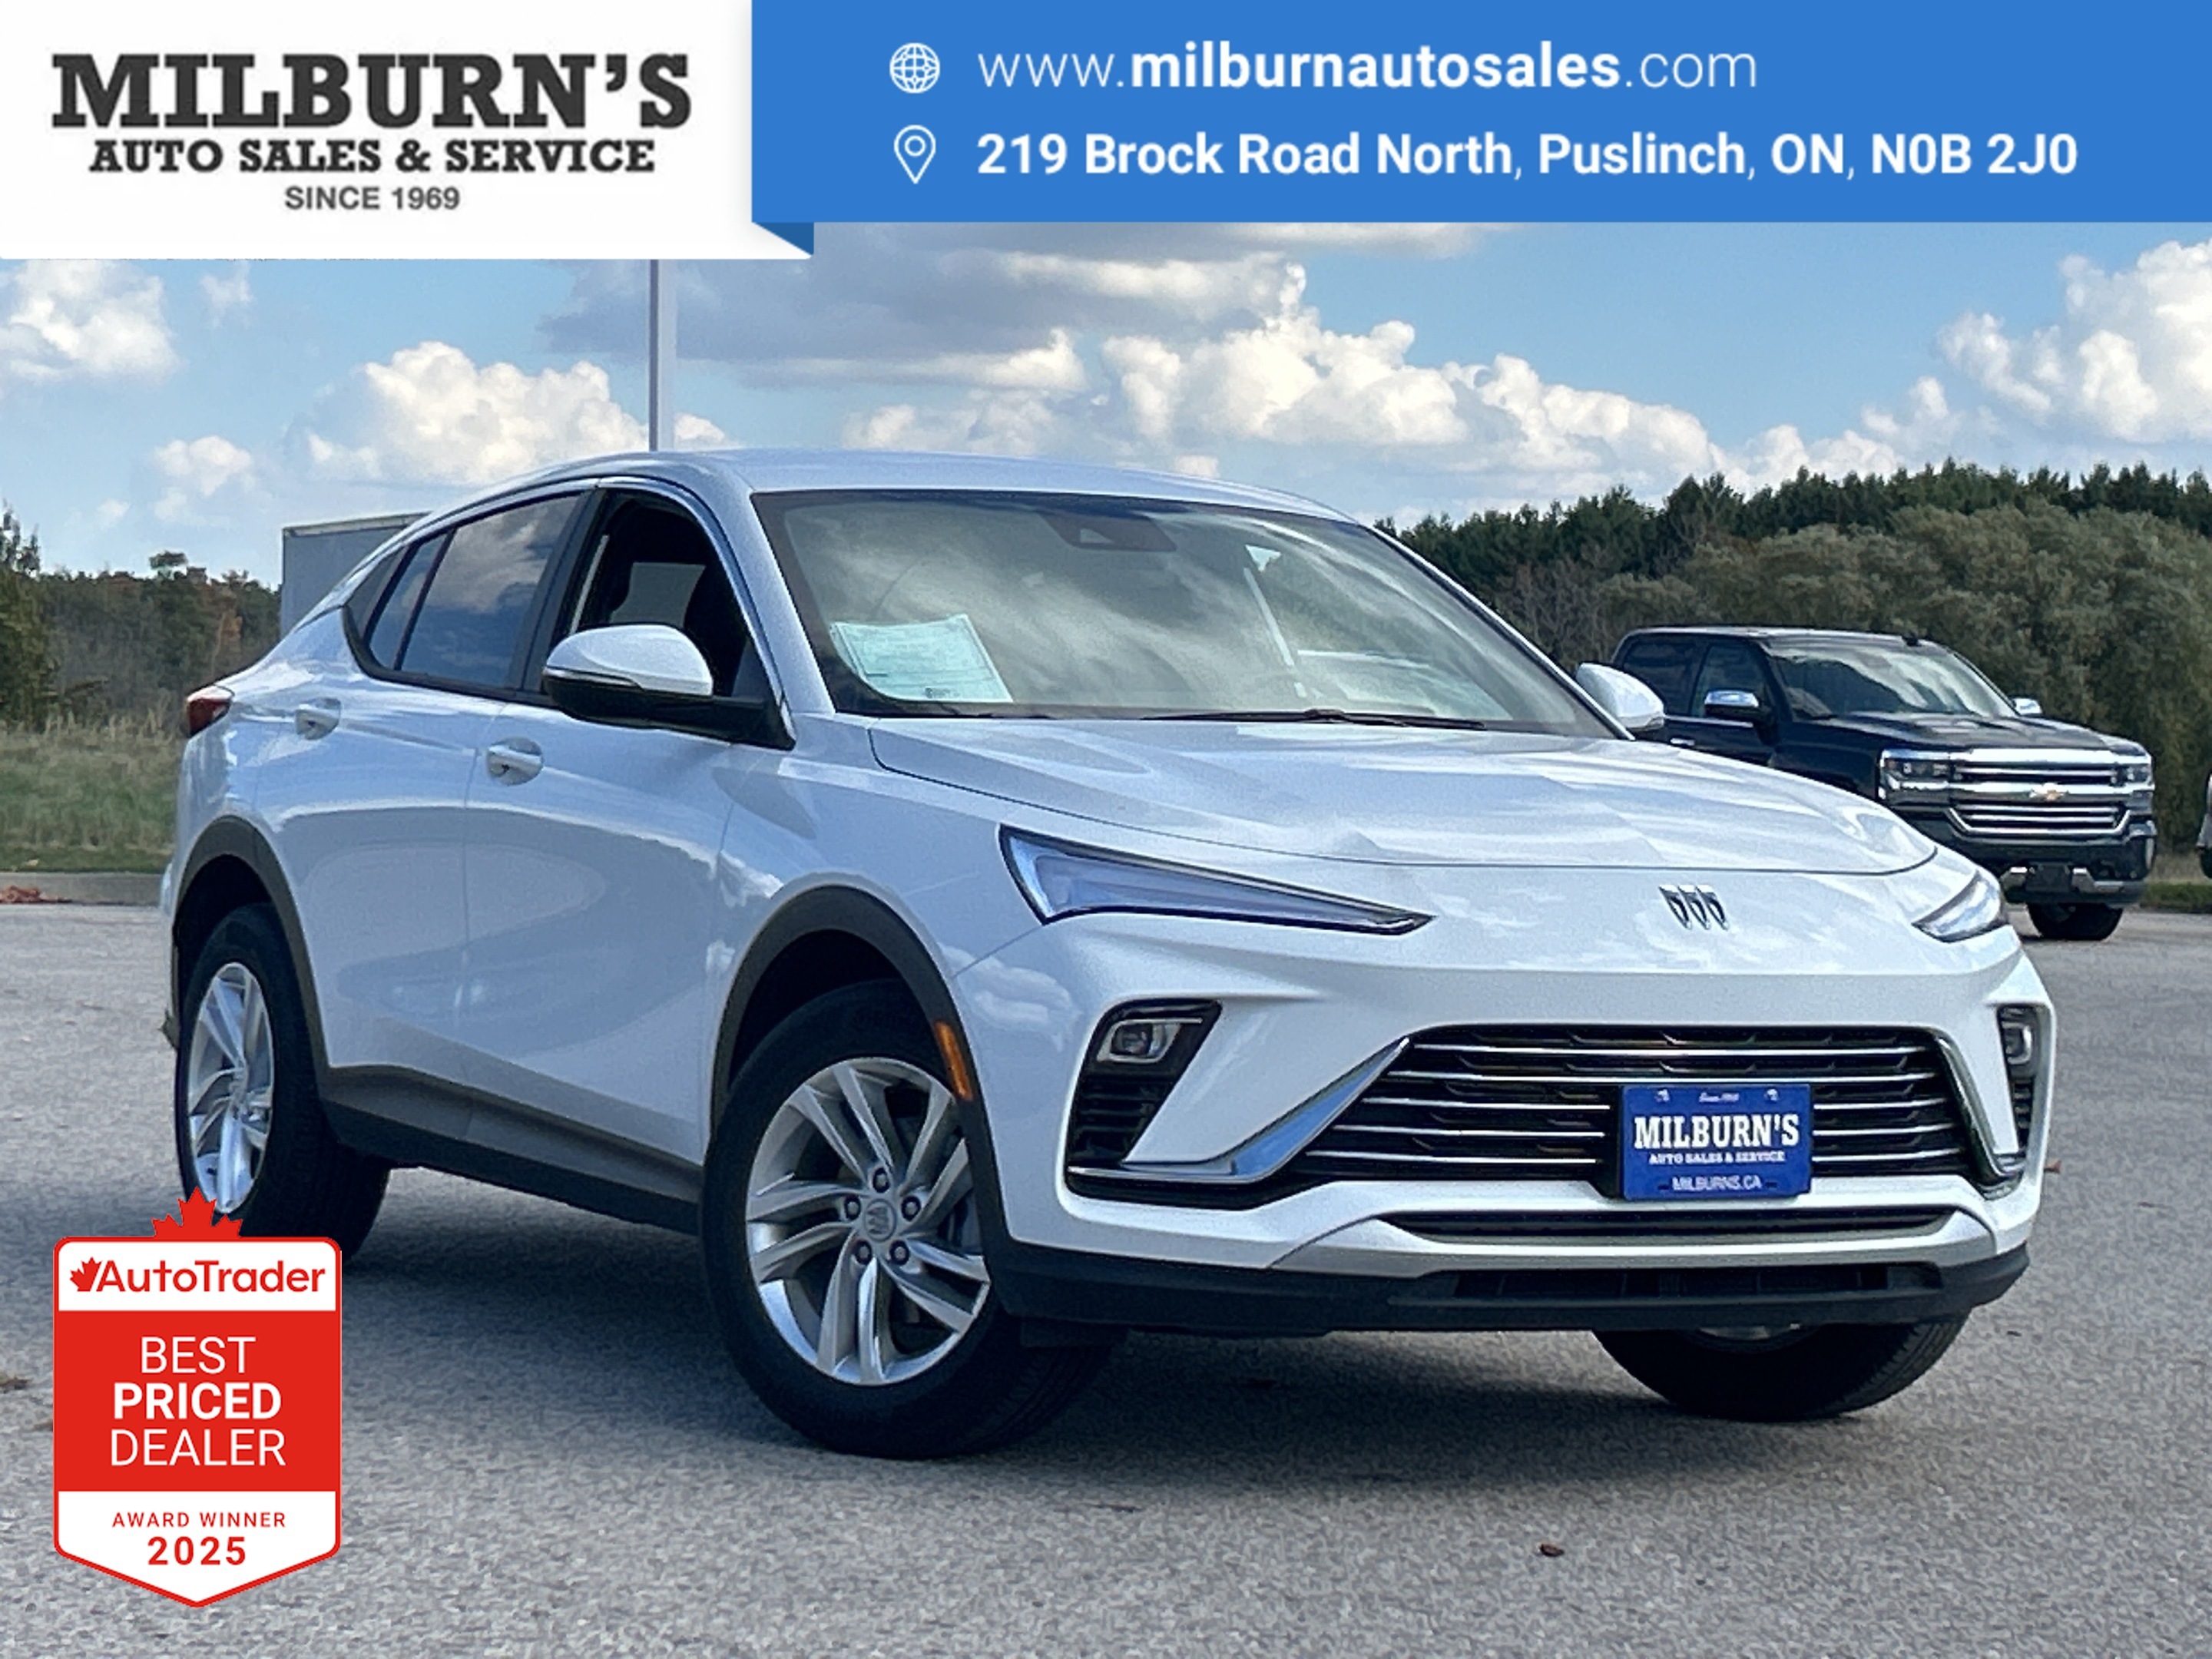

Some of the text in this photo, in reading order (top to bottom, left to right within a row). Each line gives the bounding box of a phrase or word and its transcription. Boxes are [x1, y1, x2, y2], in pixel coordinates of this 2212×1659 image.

[1634, 1114, 1800, 1149] MILBURN'S
[1649, 1152, 1684, 1165] AUTO
[1685, 1152, 1724, 1164] SALES
